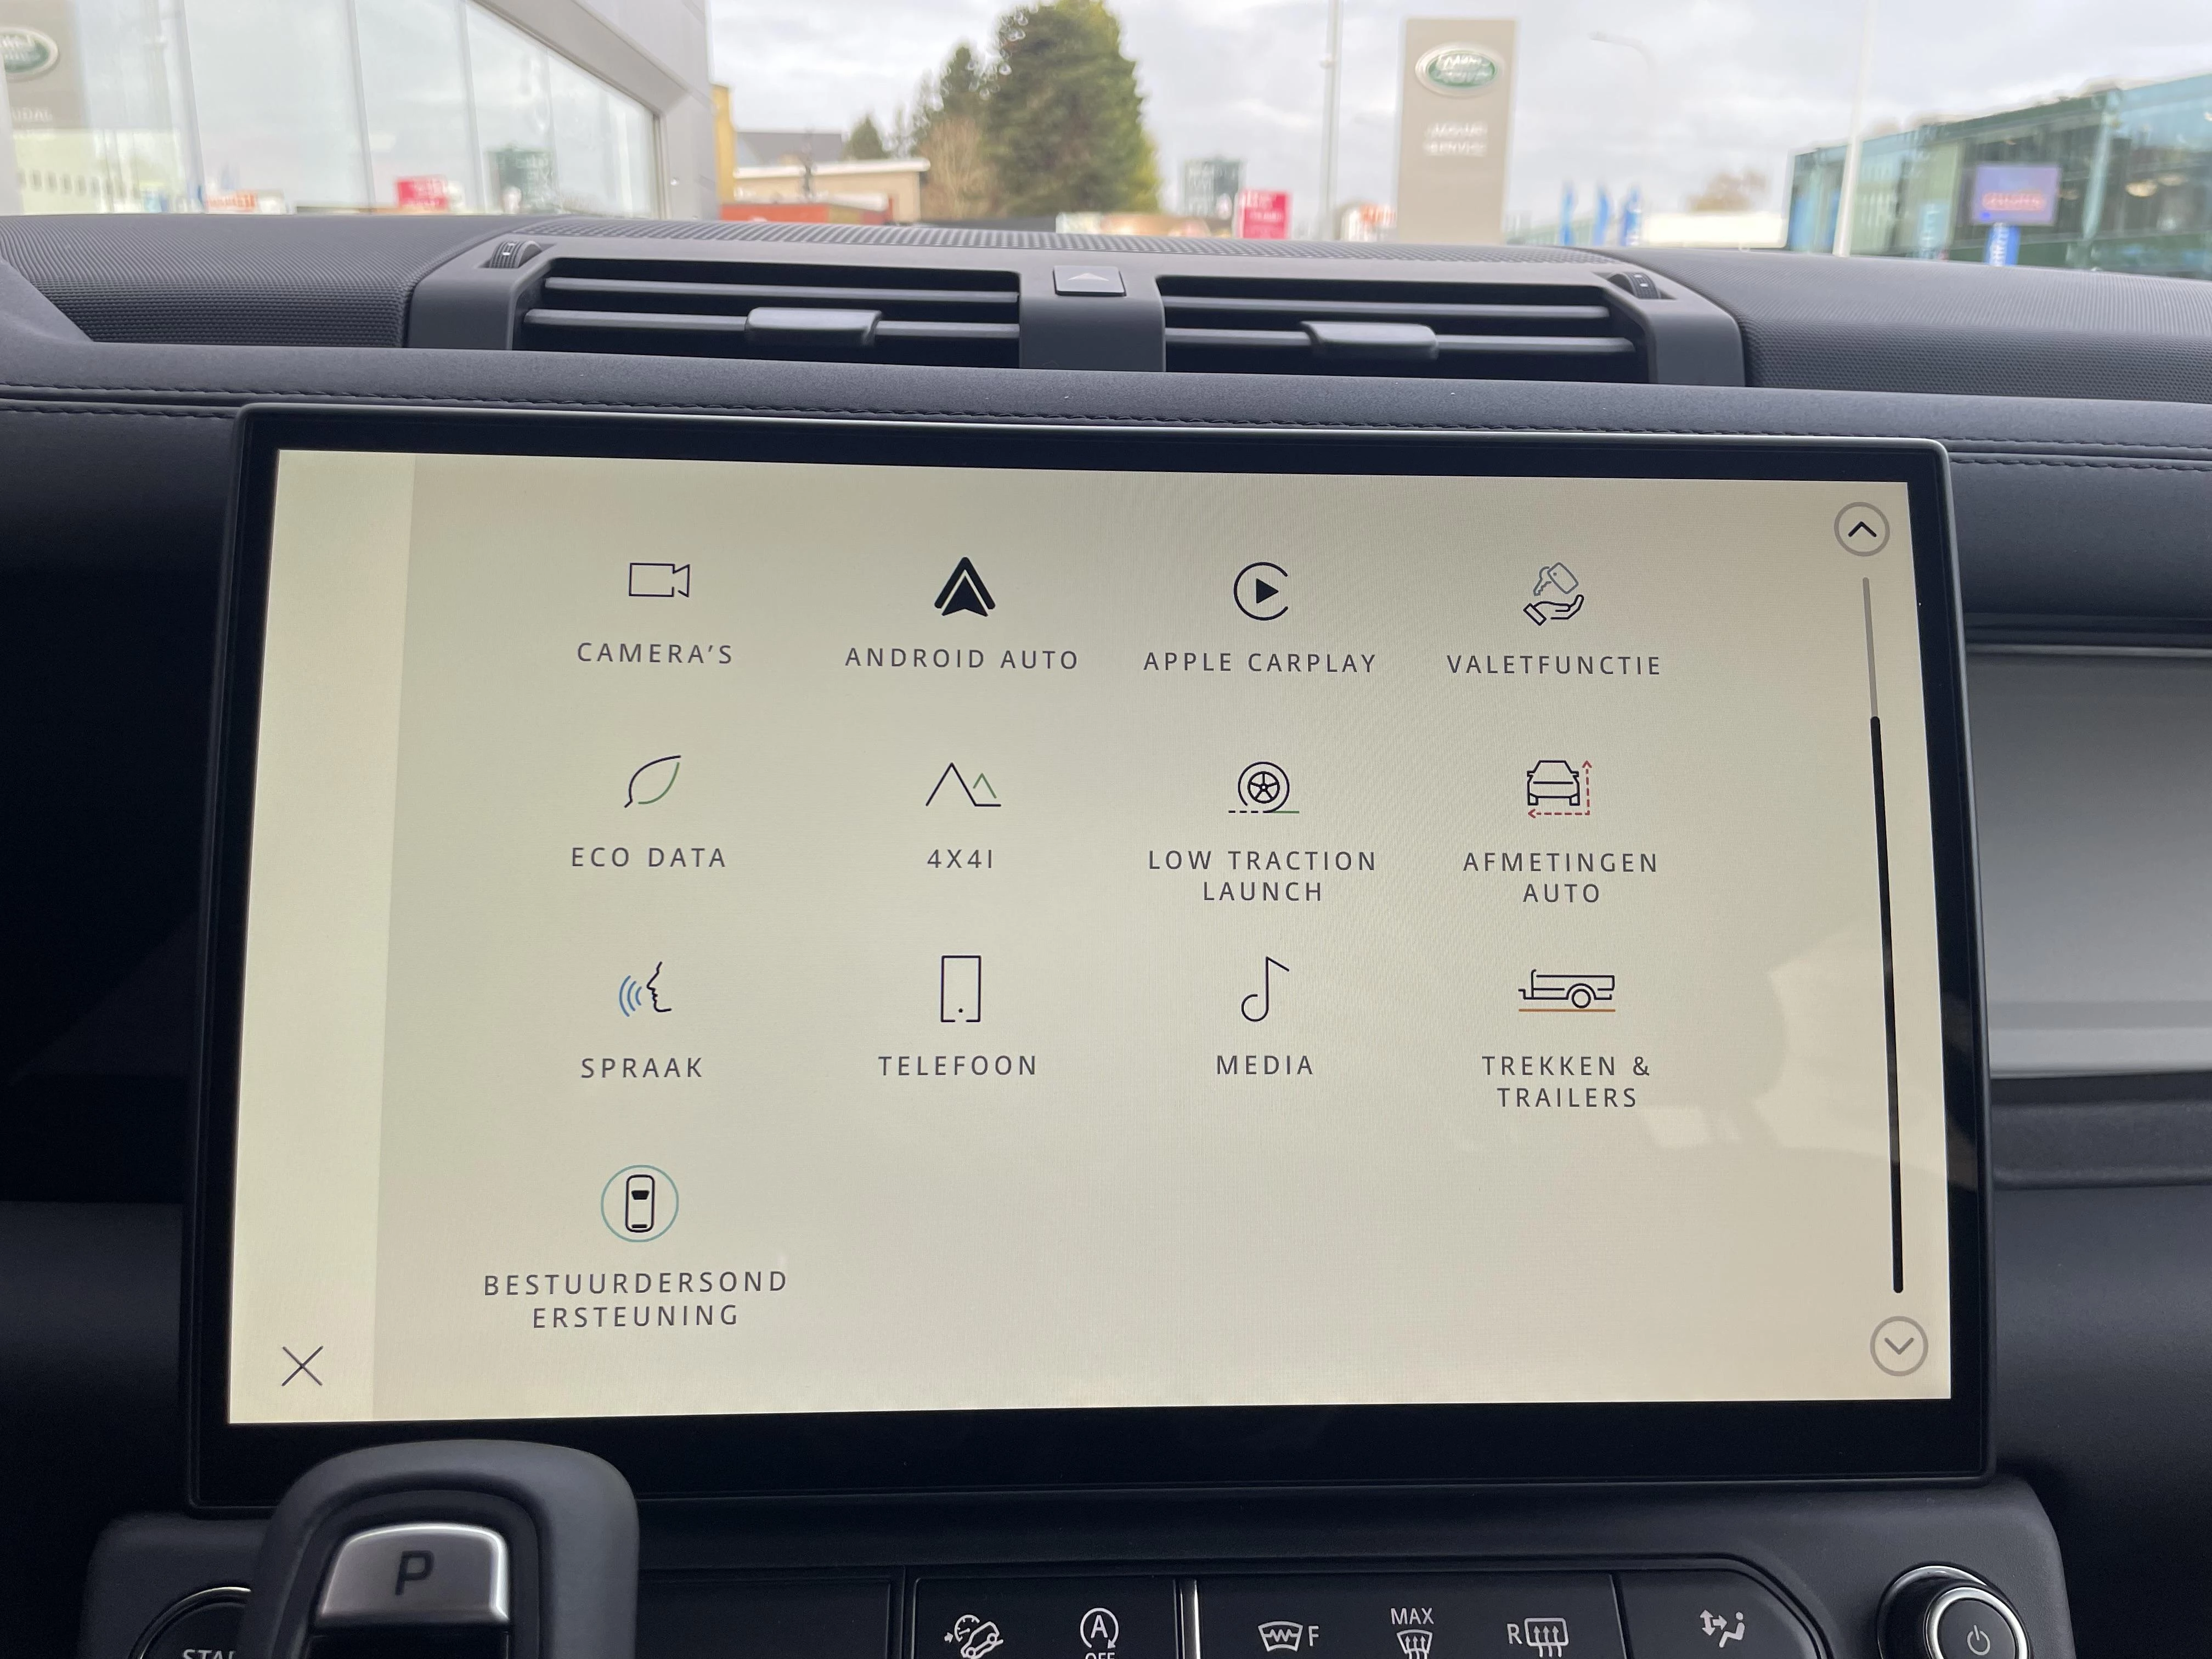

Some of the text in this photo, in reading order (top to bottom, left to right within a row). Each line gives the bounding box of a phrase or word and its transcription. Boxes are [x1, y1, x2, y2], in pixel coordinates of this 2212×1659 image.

[844, 647, 1079, 670] ANDROID AUTO
[1143, 652, 1376, 674] APPLE CARPLAY
[1446, 654, 1661, 675] VALETFUNCTIE
[572, 847, 726, 868] ECO DATA
[927, 849, 994, 869] 4X4I
[1149, 850, 1376, 871] LOW TRACTION
[1463, 851, 1657, 873] AFMETINGEN
[1203, 881, 1322, 902] LAUNCH
[1522, 883, 1600, 904] AUTO
[580, 1057, 703, 1079] SPRAAK
[878, 1054, 1037, 1076] TELEFOON
[1216, 1054, 1313, 1075] MEDIA
[1481, 1056, 1650, 1077] TREKKEN &
[1497, 1087, 1637, 1108] TRAILERS
[484, 1270, 787, 1296] BESTUURDERSOND
[533, 1304, 738, 1329] ERSTEUNING
[394, 1550, 435, 1596] P
[1090, 1614, 1109, 1639] A
[1390, 1607, 1434, 1625] MAX
[1308, 1625, 1320, 1646] F
[1506, 1622, 1523, 1645] R
